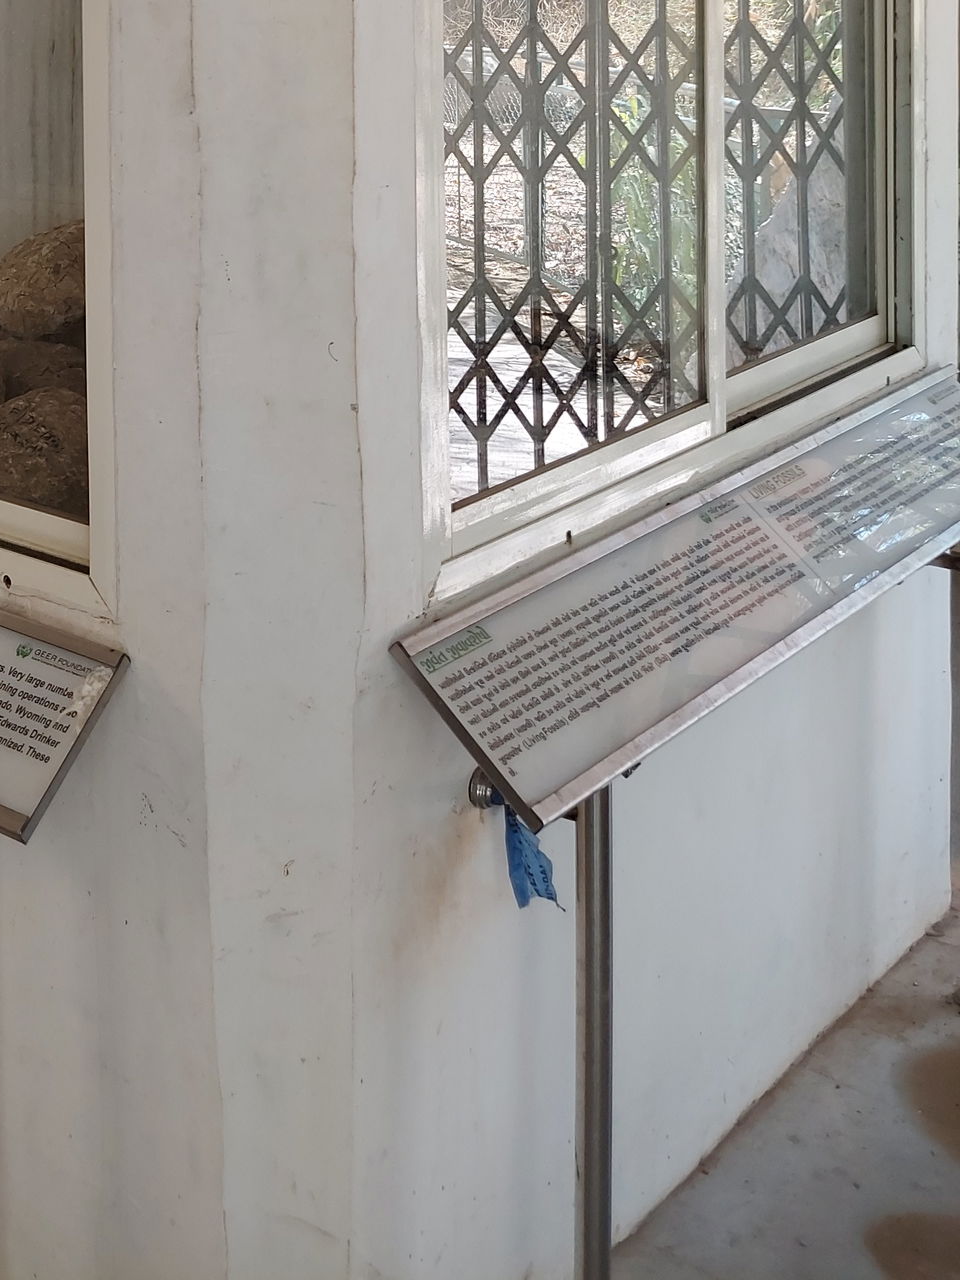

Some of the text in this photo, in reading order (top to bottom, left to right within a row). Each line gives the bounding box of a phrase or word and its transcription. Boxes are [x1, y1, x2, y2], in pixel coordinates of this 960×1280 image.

[749, 464, 805, 500] LIVING FOSSILS
[34, 649, 57, 661] GEER
[8, 666, 25, 681] Very
[24, 673, 45, 688] large
[45, 683, 73, 699] numbe
[17, 690, 59, 711] operations
[59, 706, 77, 718] aso
[15, 704, 52, 728] Wyoming
[52, 722, 70, 733] and
[29, 729, 60, 748] Drinker
[26, 745, 50, 763] These
